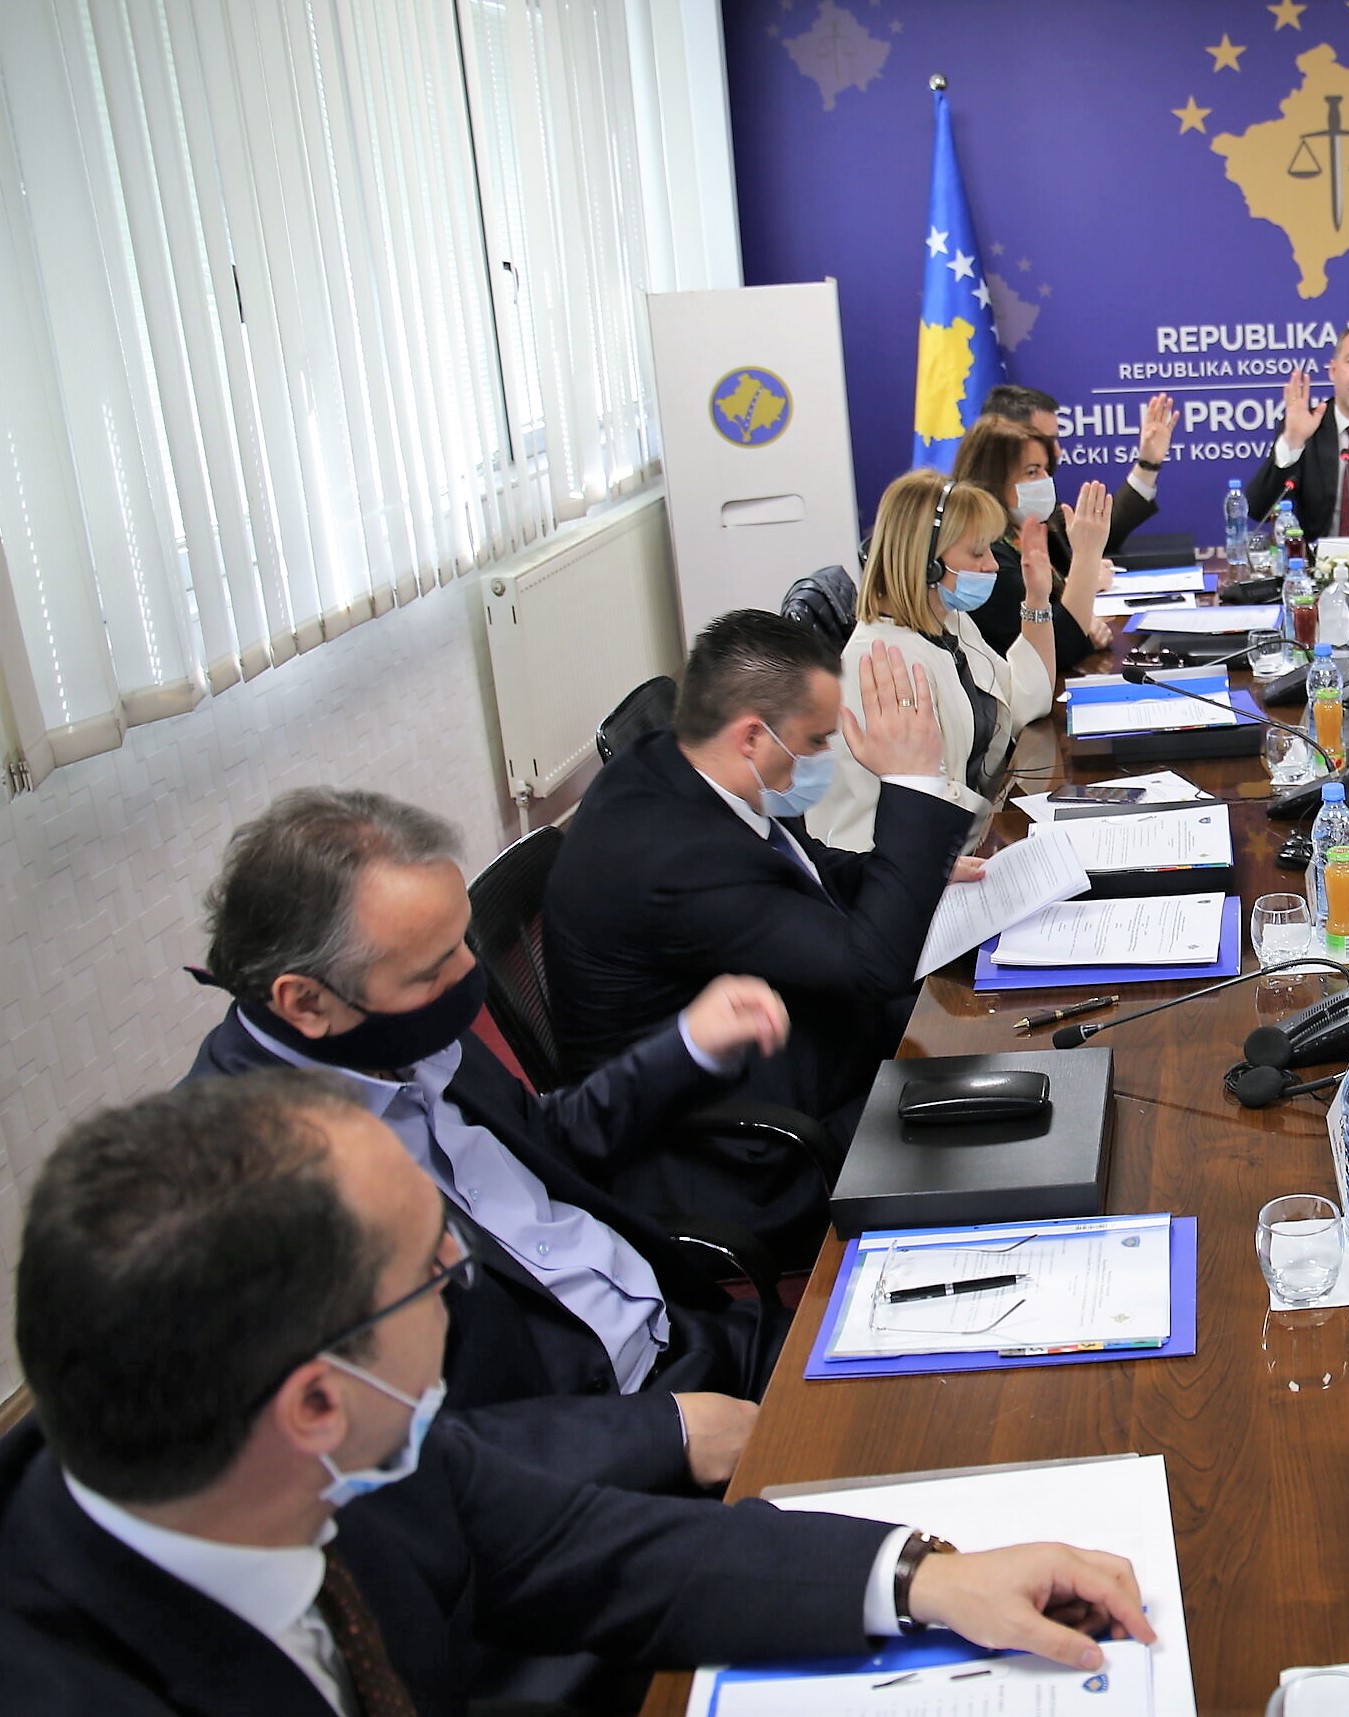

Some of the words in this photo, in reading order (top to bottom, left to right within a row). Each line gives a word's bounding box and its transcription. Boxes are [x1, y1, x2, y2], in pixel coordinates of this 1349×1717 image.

[1157, 322, 1338, 353] REPUBLIKA
[1118, 361, 1233, 380] REPUBLIKA
[1238, 357, 1319, 376] KOSOVA
